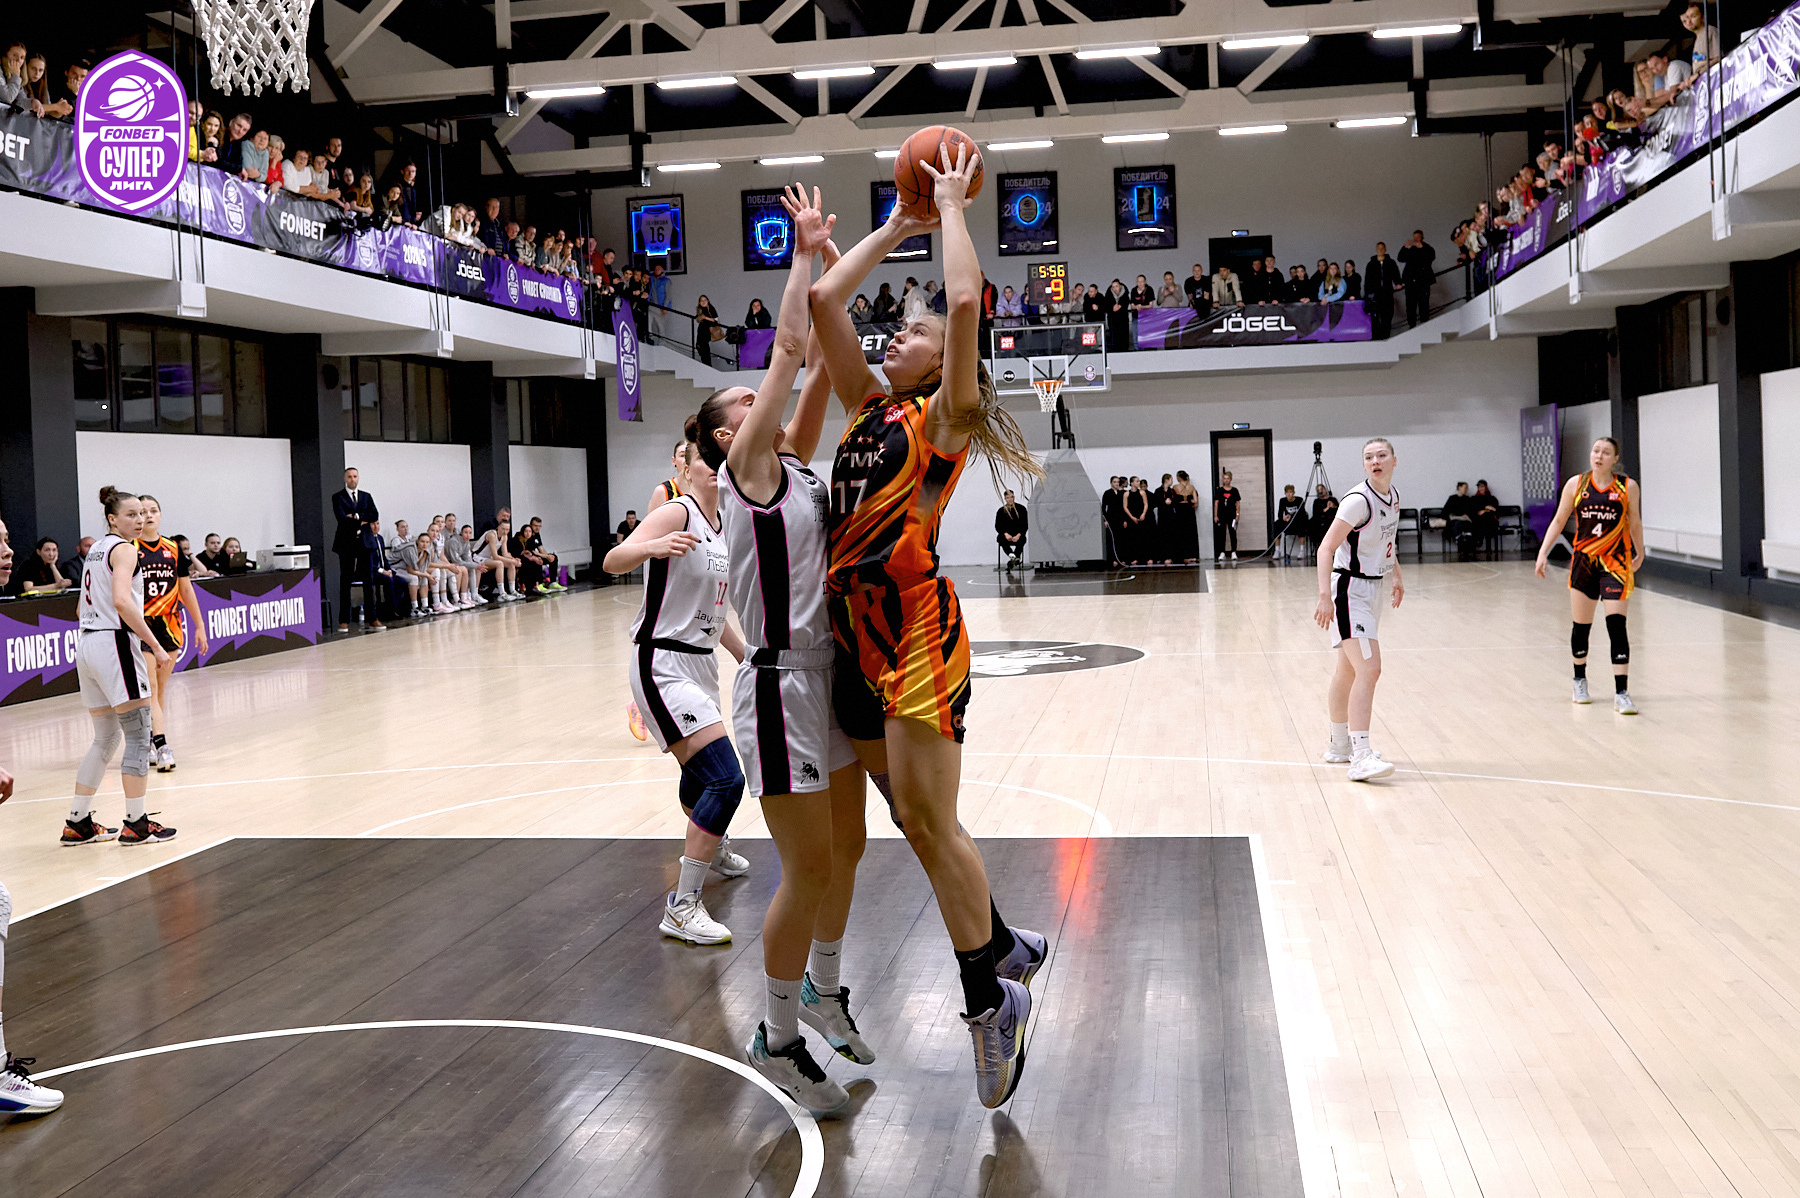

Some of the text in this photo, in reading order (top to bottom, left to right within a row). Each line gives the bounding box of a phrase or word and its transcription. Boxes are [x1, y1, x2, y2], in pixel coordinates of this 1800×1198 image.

[1004, 177, 1050, 188] ПОБЕДИТЕЛЬ
[1121, 171, 1168, 182] ПОБЕДИТЕЛЬ
[280, 212, 326, 241] FONBET
[650, 226, 665, 243] 16
[456, 260, 485, 281] JÖGEL
[1039, 265, 1065, 278] 5:56
[1050, 278, 1064, 301] 9
[1212, 313, 1296, 333] JÖGEL
[834, 478, 868, 514] 17
[1581, 510, 1617, 520] УГМК
[1592, 523, 1603, 537] 4
[1386, 541, 1393, 558] 2
[85, 569, 93, 606] 9
[148, 581, 169, 597] 87
[207, 596, 306, 640] FONBET СУПЕРЛИГА
[6, 631, 60, 674] FONBET
